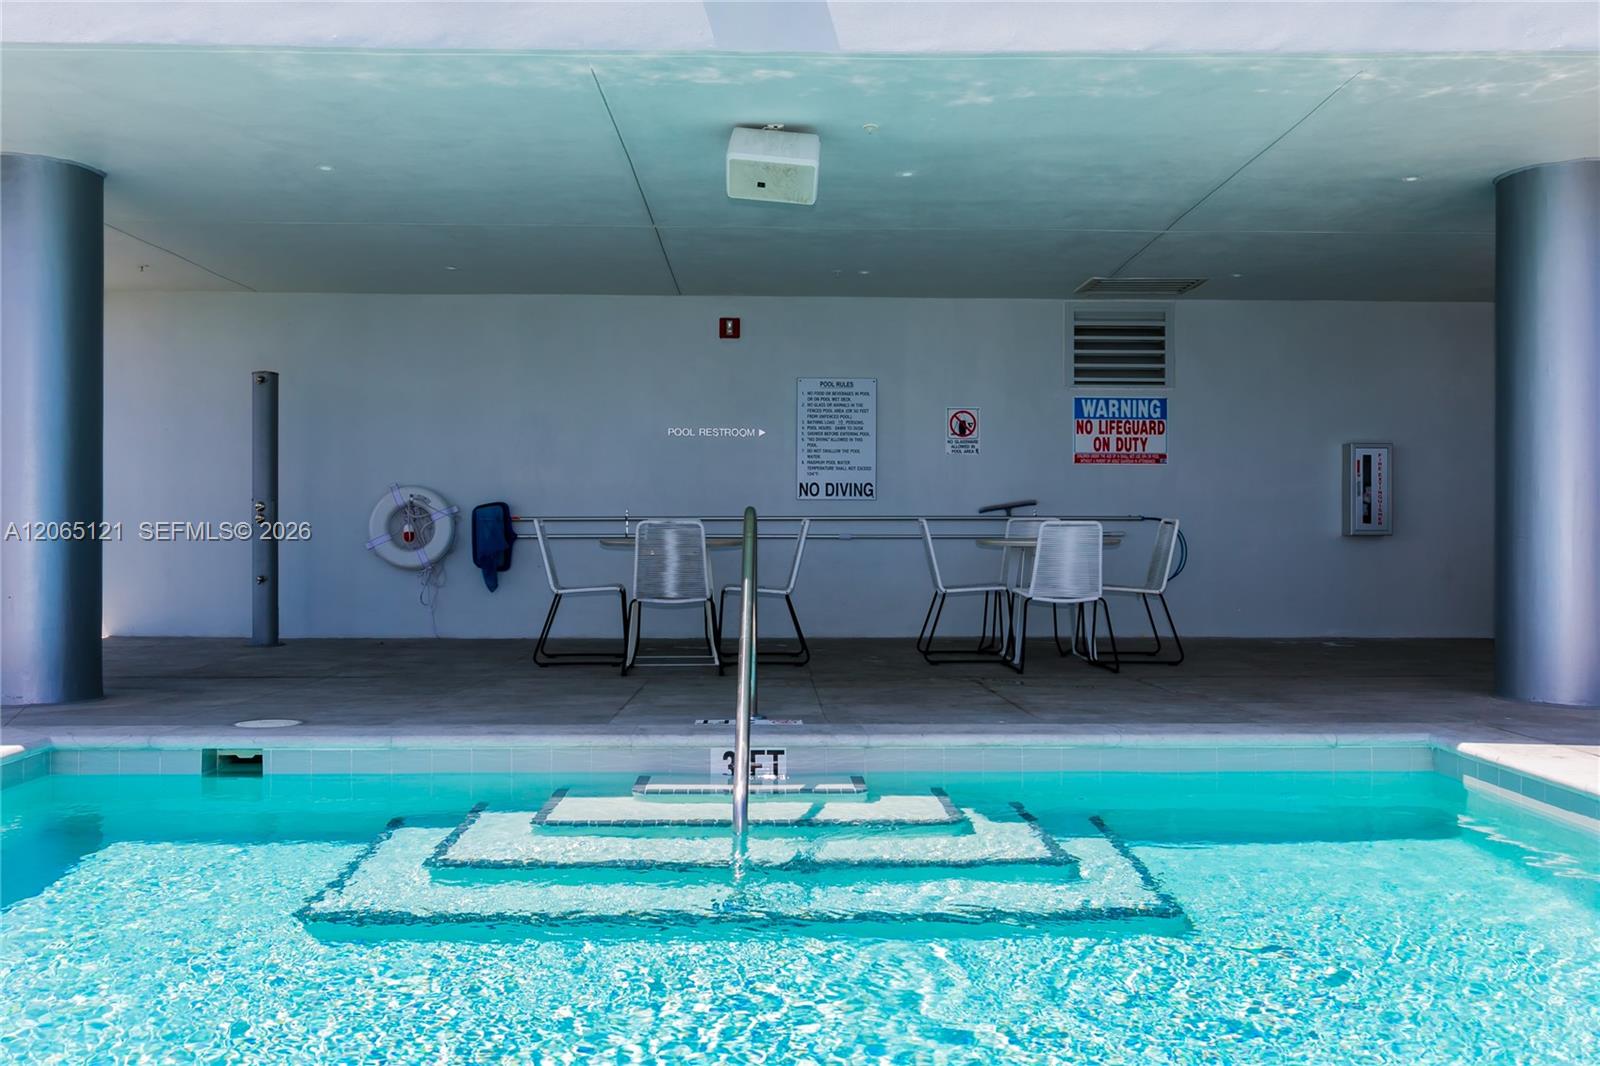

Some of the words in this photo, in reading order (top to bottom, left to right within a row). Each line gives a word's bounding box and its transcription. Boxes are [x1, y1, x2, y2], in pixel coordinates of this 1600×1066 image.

[1081, 399, 1161, 418] WARNING
[668, 428, 695, 437] POOL
[698, 428, 755, 437] RESTROOM
[1076, 420, 1093, 435] NO
[1098, 420, 1165, 435] LIFEGUARD
[1093, 437, 1110, 452] ON
[1116, 437, 1148, 452] DUTY
[799, 482, 820, 497] NO
[825, 482, 874, 497] DIVING
[750, 750, 785, 776] FT
